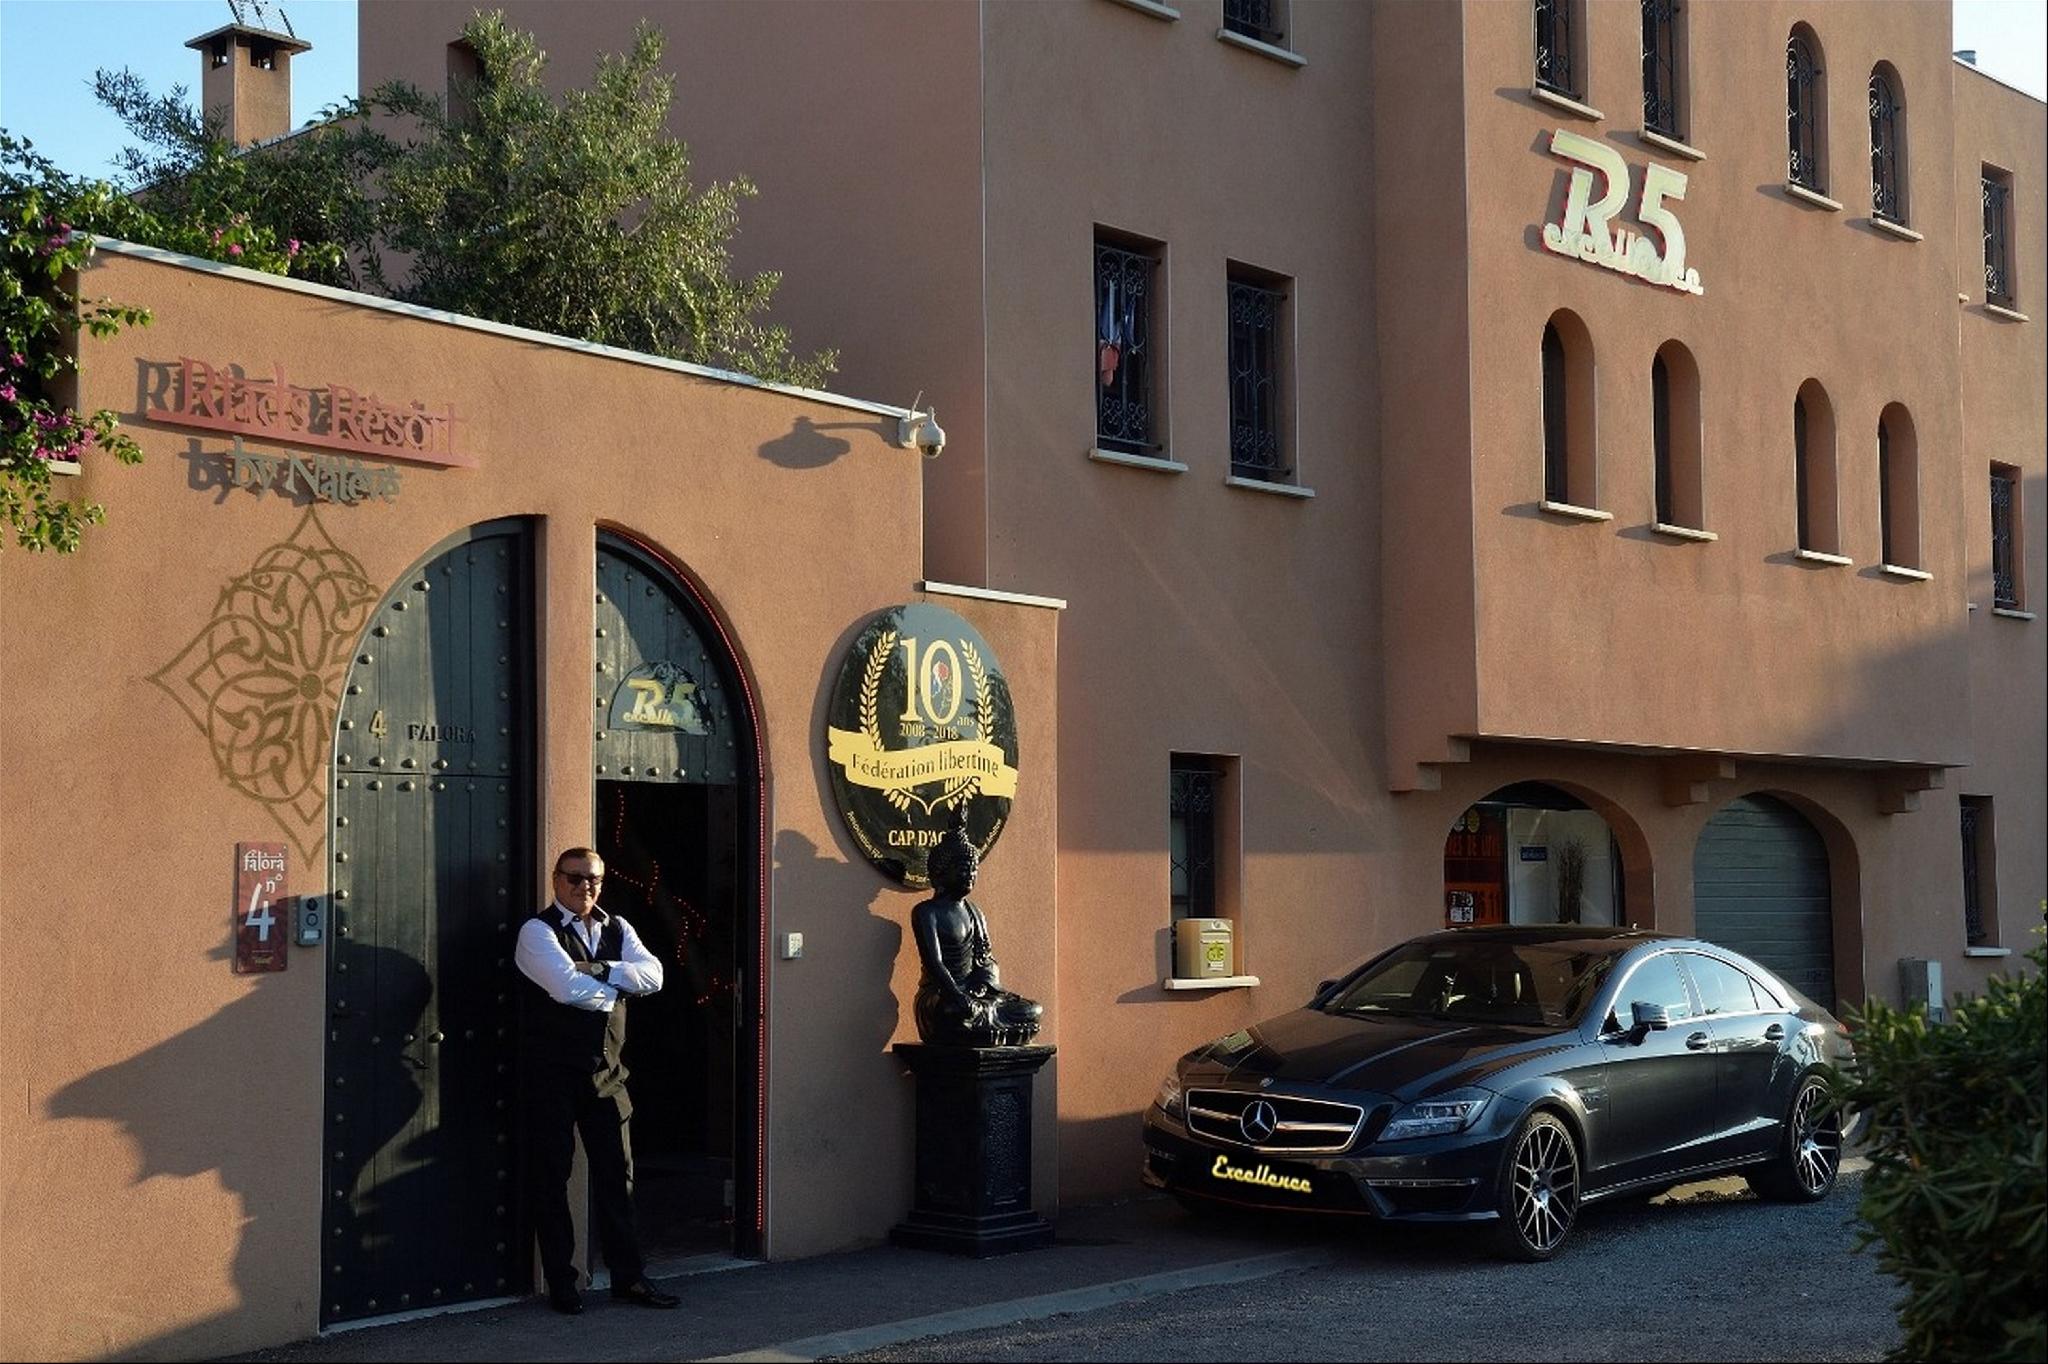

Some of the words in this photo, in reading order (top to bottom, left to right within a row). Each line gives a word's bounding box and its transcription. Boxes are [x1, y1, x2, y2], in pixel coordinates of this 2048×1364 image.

[1551, 128, 1688, 278] R5
[231, 435, 279, 501] by
[900, 638, 961, 724] 10
[369, 709, 388, 739] 4
[851, 752, 935, 781] Fédération
[938, 748, 1000, 779] libertine
[888, 829, 915, 846] CAP
[245, 883, 276, 942] 4
[1211, 1154, 1312, 1194] Excellence
